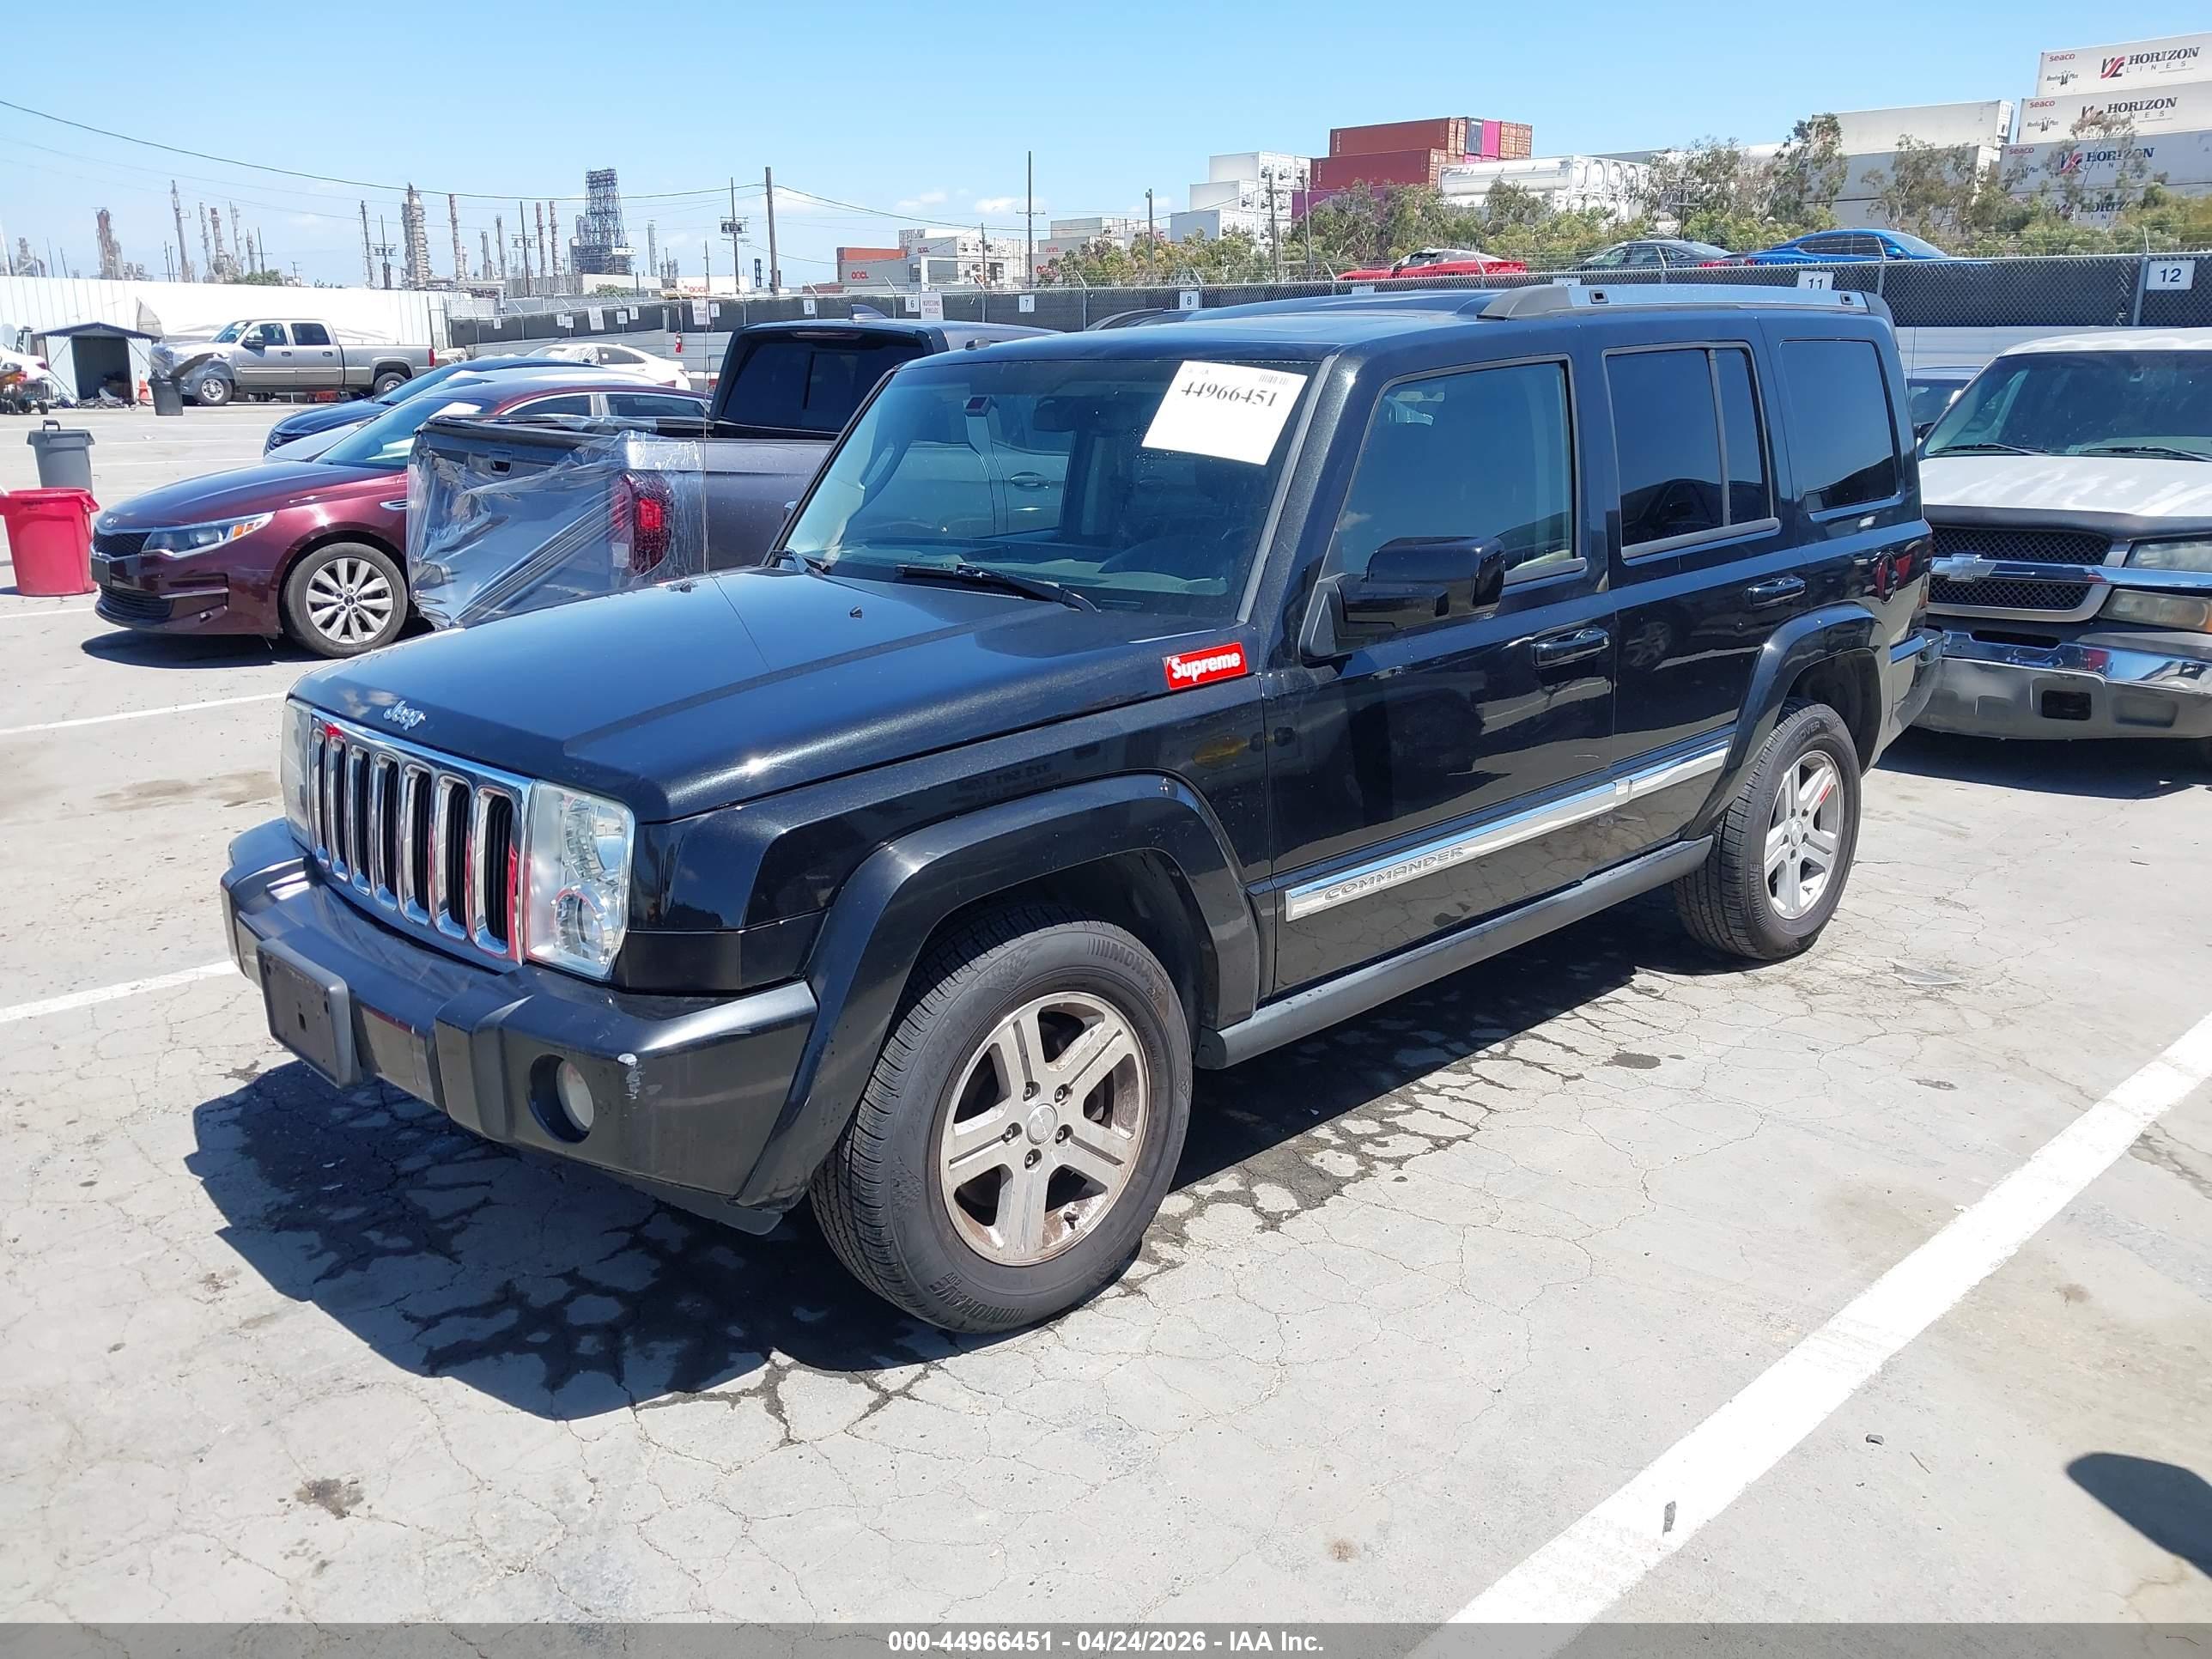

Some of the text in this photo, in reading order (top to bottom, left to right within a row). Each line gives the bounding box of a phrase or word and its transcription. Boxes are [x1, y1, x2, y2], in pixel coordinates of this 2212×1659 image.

[2048, 53, 2075, 62] seaco
[2128, 46, 2200, 65] HORIZON
[2126, 60, 2187, 74] LINES
[2029, 100, 2056, 108] seaco
[2106, 96, 2179, 114] HORIZON
[2008, 147, 2034, 155] seaco
[852, 270, 869, 279] OOCL
[2160, 266, 2182, 283] 12
[1808, 277, 1823, 289] 11
[1024, 299, 1030, 308] 7
[1186, 295, 1192, 306] 8
[1181, 380, 1278, 407] 44966451
[1171, 652, 1241, 682] Supreme
[383, 700, 427, 732] Jeep
[1324, 846, 1464, 902] COMMANDER
